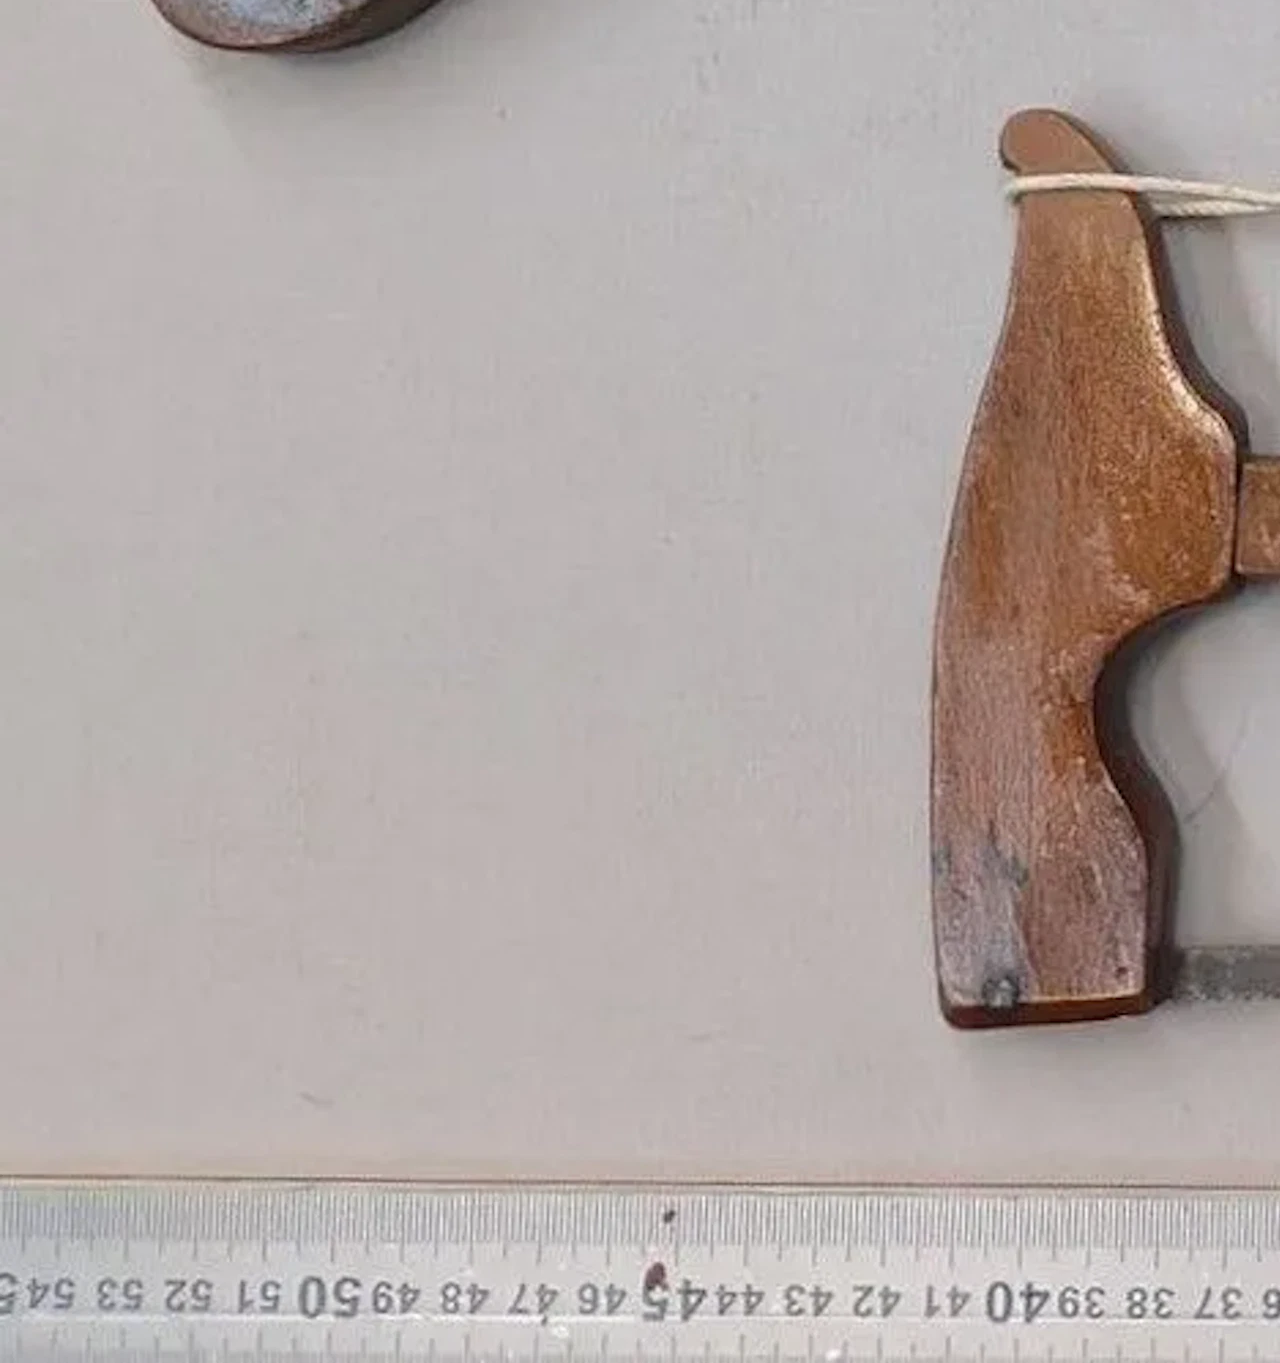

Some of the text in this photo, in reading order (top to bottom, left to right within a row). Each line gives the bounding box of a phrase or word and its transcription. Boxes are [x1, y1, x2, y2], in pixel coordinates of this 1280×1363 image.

[26, 1277, 76, 1311] 54
[96, 1277, 144, 1313] 53
[164, 1278, 214, 1313] 52
[237, 1279, 282, 1315] 51
[297, 1275, 363, 1320] 50
[371, 1280, 422, 1315] 49
[440, 1281, 491, 1315] 48
[507, 1282, 560, 1315] 47
[577, 1282, 628, 1316] 46
[641, 1278, 709, 1323] 45
[714, 1283, 766, 1317] 44
[783, 1283, 835, 1318] 43
[852, 1284, 902, 1319] 42
[923, 1284, 972, 1319] 41
[984, 1280, 1052, 1325] 40
[1057, 1285, 1106, 1320] 39
[1125, 1286, 1176, 1320] 38
[1192, 1286, 1244, 1321] 37
